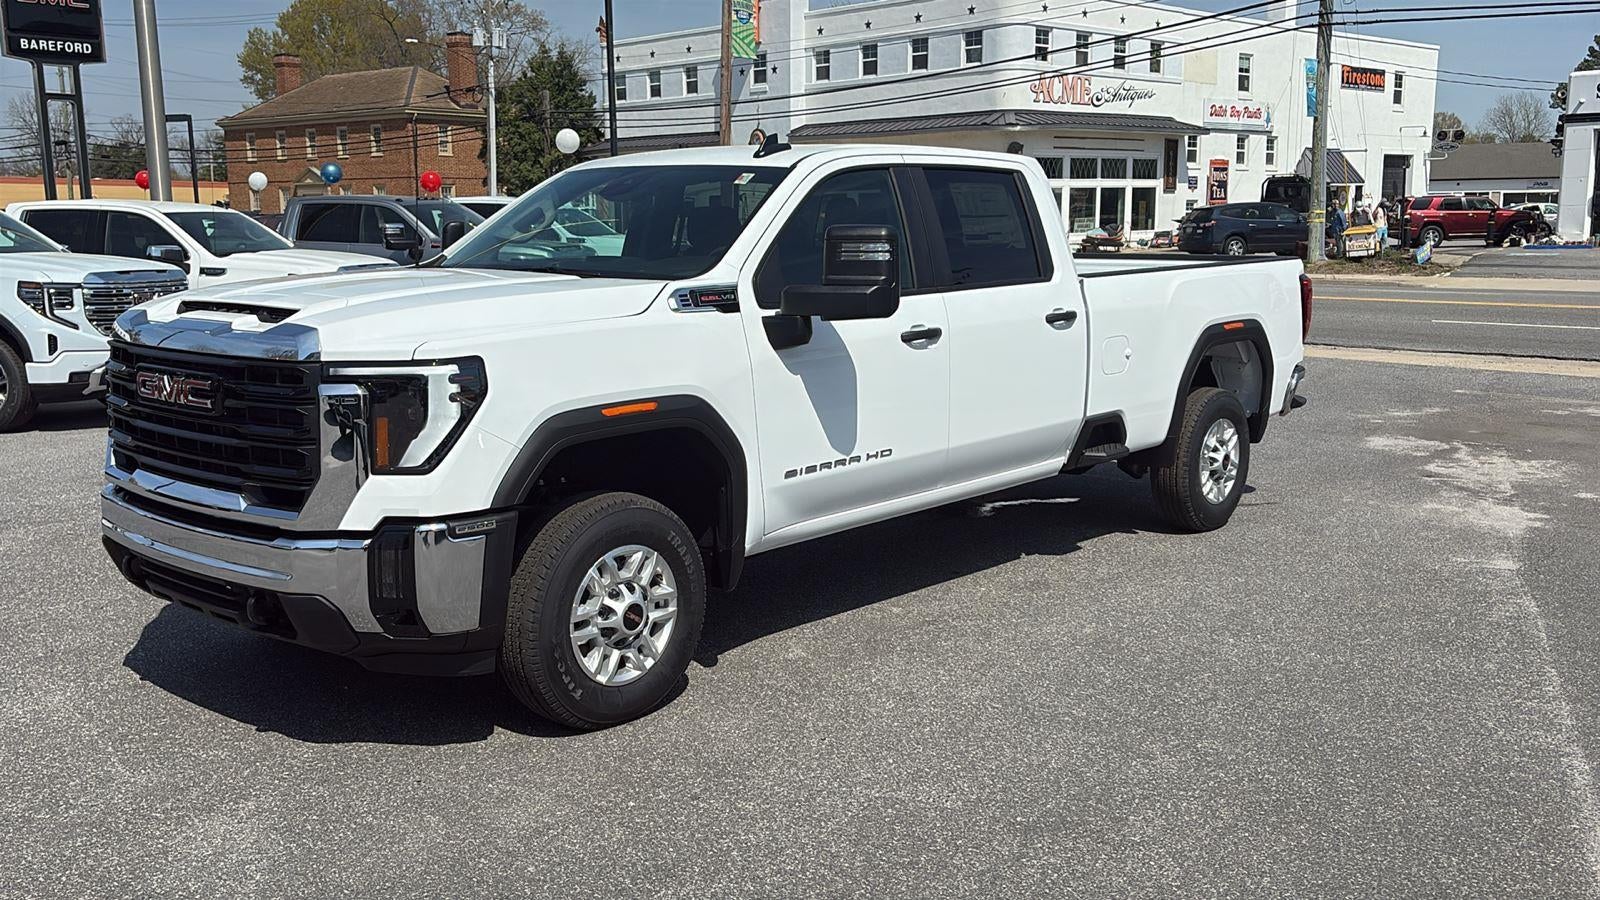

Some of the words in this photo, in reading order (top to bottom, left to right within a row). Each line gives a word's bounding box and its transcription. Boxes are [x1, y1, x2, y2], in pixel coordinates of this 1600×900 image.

[20, 38, 92, 54] BAREFORD
[1342, 65, 1385, 87] Firestone
[1030, 73, 1092, 105] ACME
[1209, 104, 1228, 118] Dutch
[1230, 105, 1242, 121] Boy
[1242, 106, 1262, 119] Paints
[1212, 186, 1225, 199] TEA
[136, 371, 213, 409] GMC
[784, 455, 862, 480] SIERRA
[866, 448, 893, 461] HD
